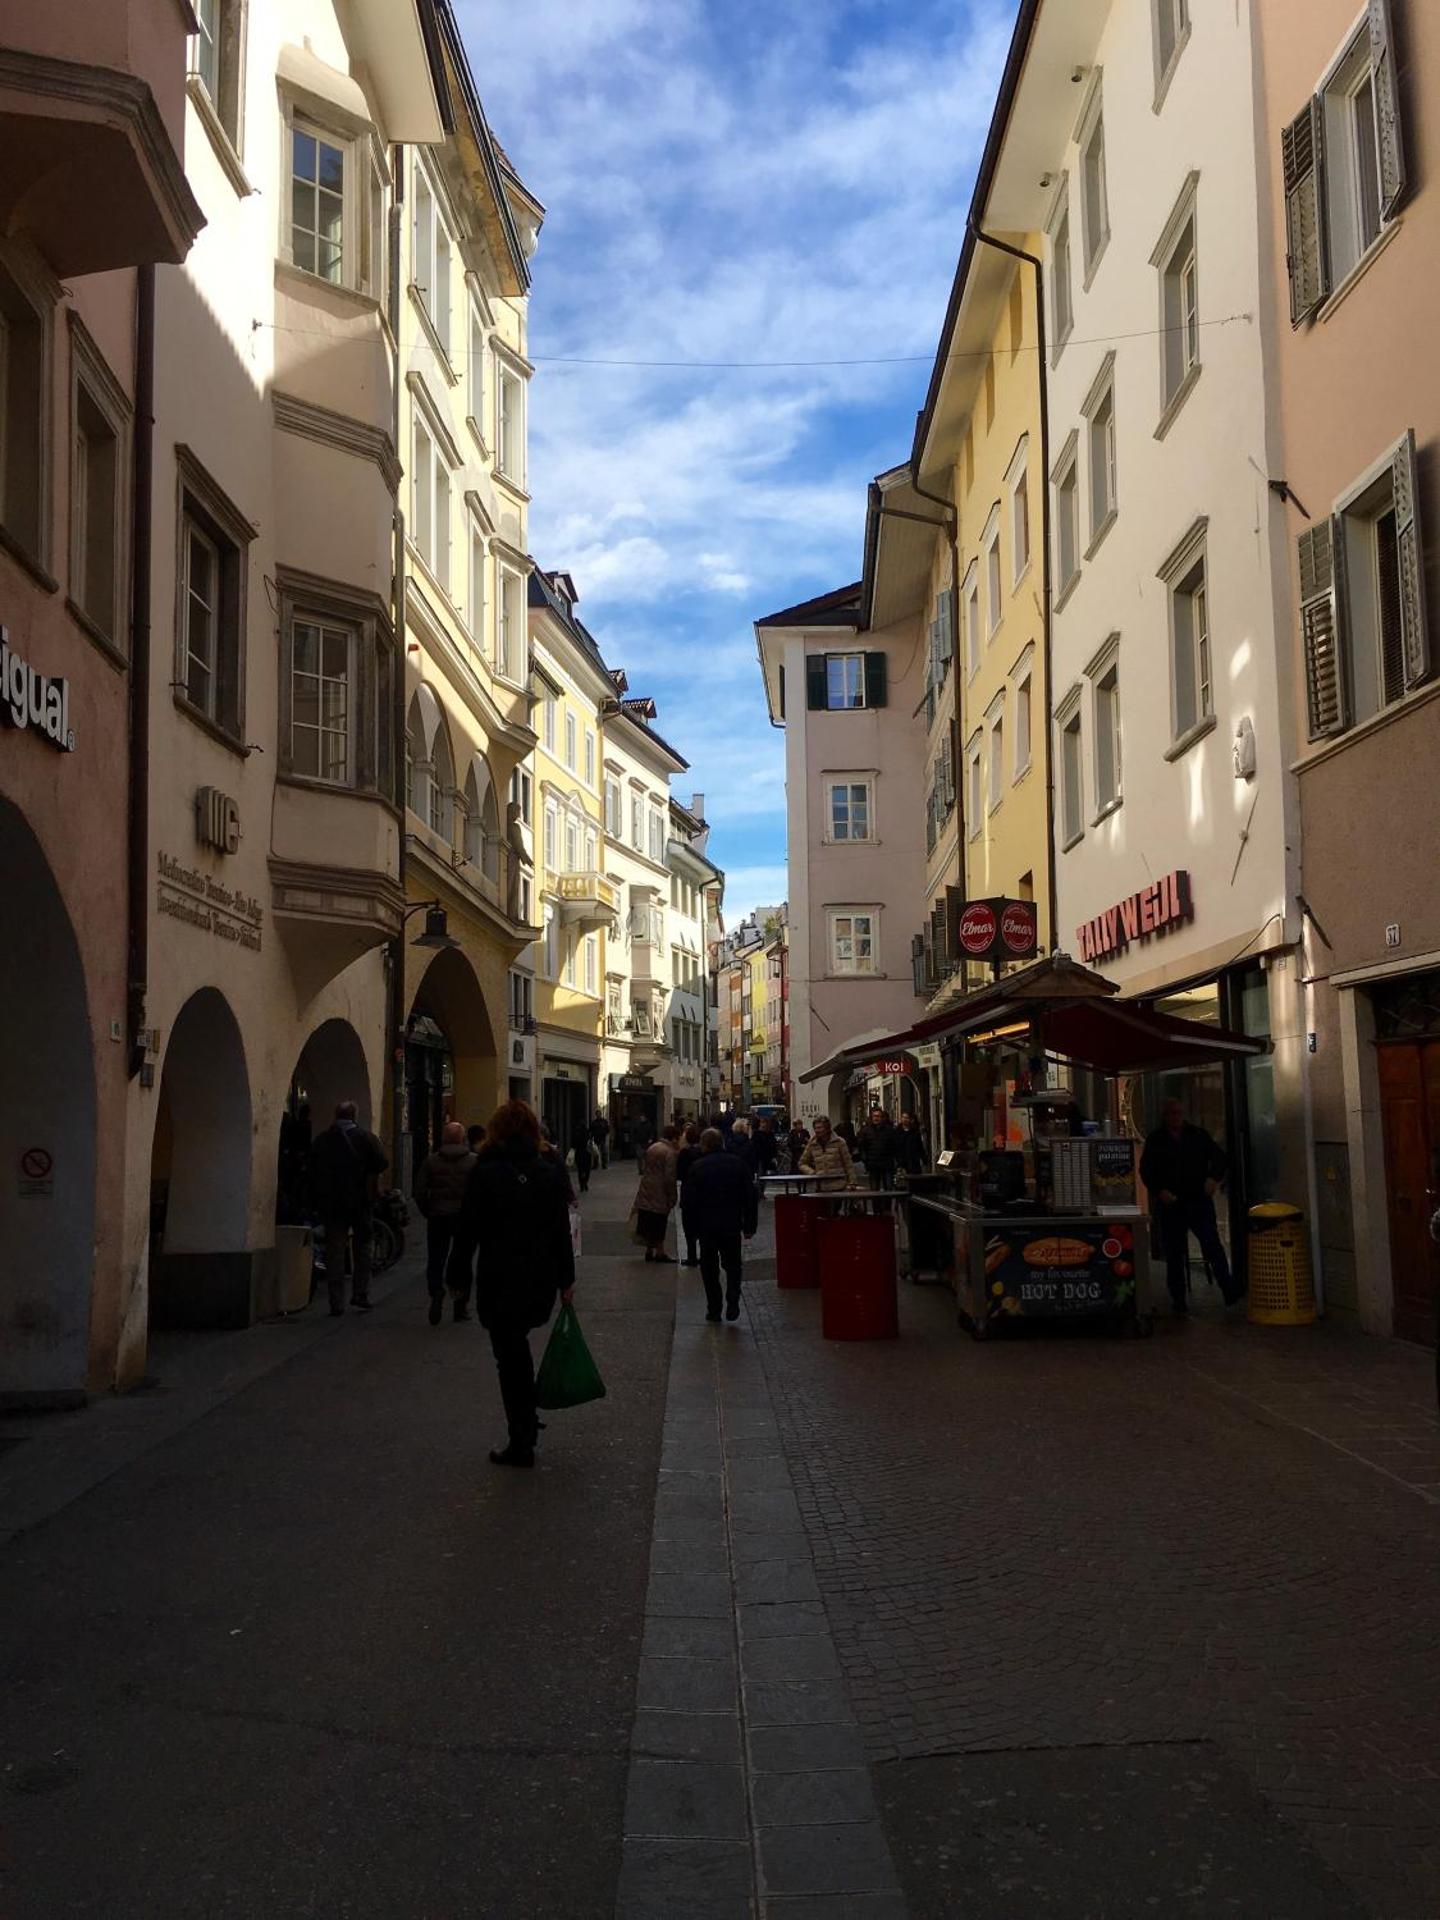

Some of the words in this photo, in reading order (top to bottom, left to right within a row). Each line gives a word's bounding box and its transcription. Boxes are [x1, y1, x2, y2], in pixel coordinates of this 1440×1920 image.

[0, 625, 69, 747] igual
[962, 920, 993, 936] Elmar
[1004, 919, 1033, 936] Elmar
[1076, 904, 1119, 963] TALLY
[1021, 1283, 1057, 1300] HOT
[1063, 1281, 1102, 1299] DOG
